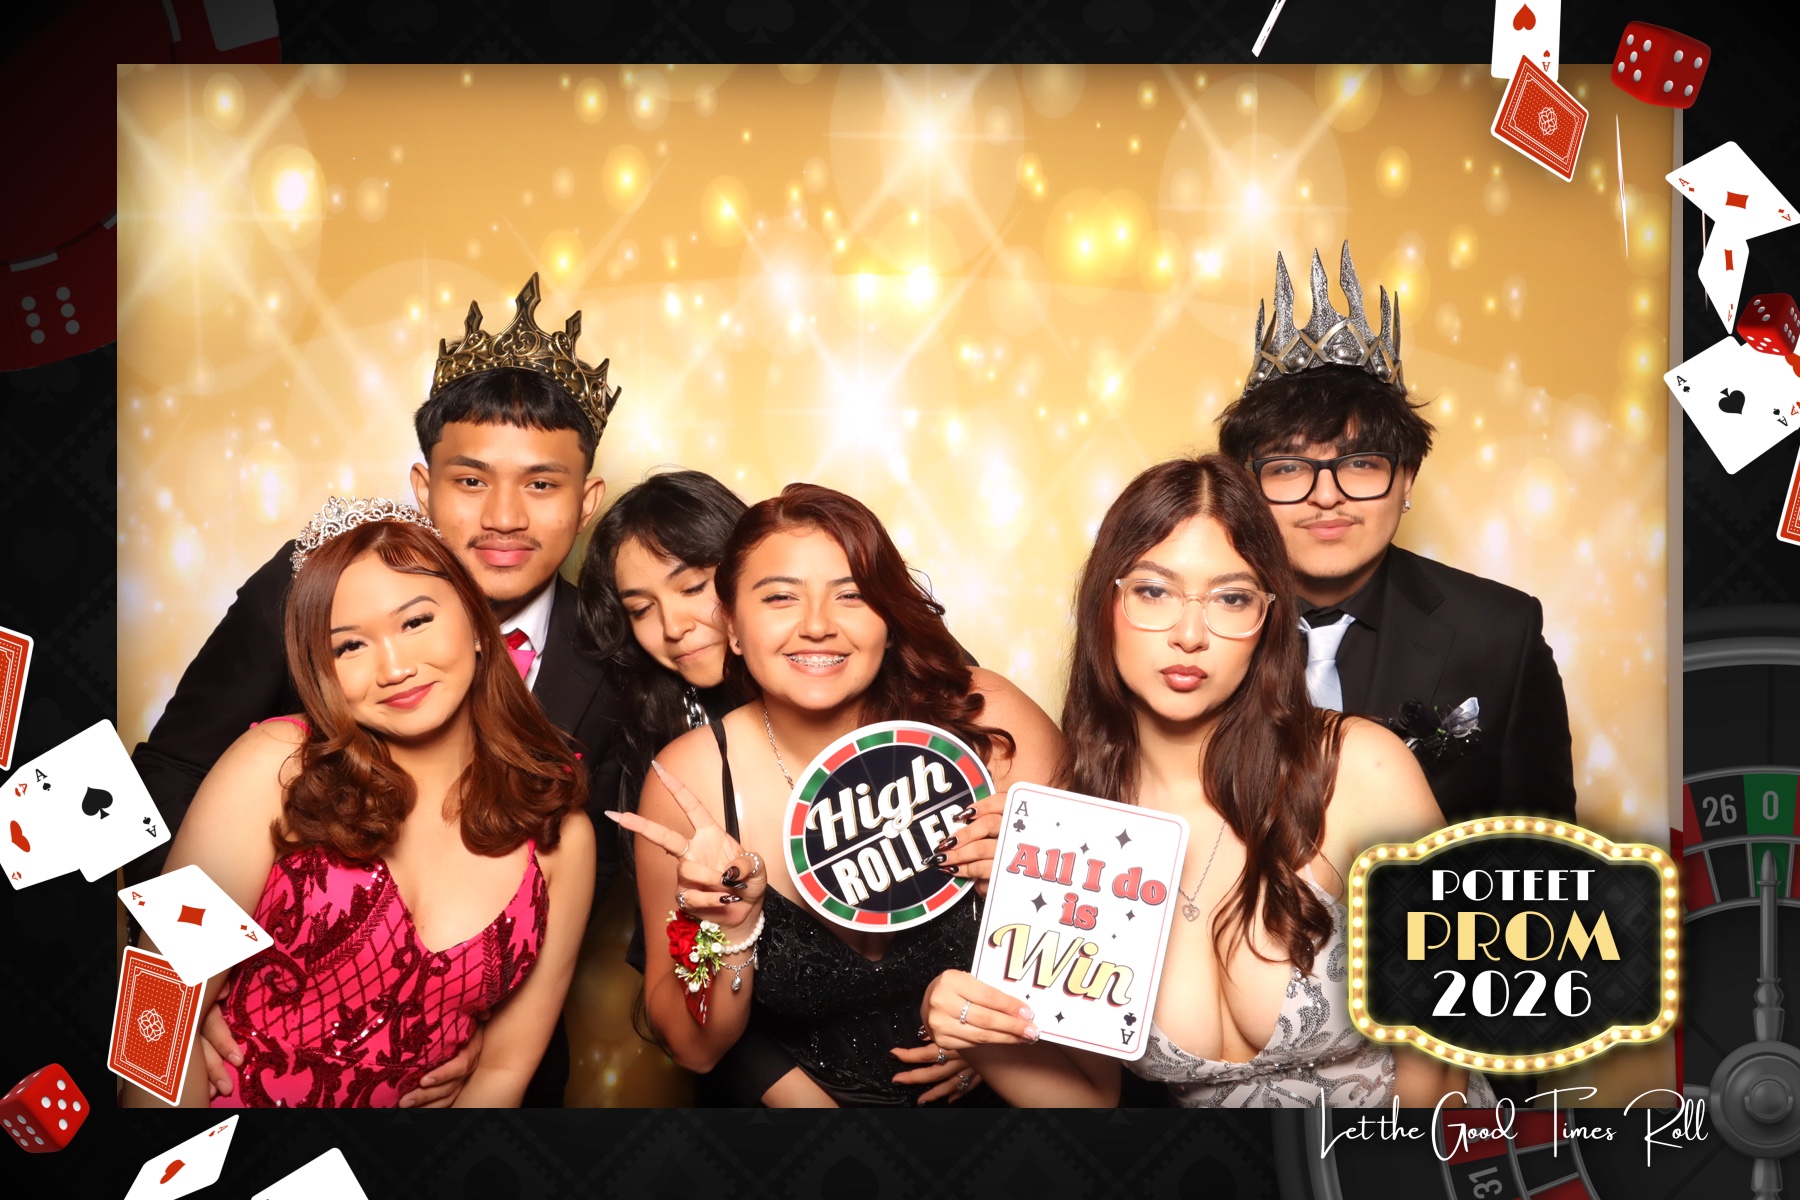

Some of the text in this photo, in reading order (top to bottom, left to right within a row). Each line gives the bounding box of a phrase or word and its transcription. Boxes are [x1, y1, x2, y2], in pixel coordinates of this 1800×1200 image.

[805, 754, 953, 851] High
[1014, 800, 1029, 817] A
[1006, 842, 1167, 906] All I do
[1058, 892, 1098, 931] is
[988, 923, 1134, 1008] Win
[1120, 1028, 1135, 1045] A
